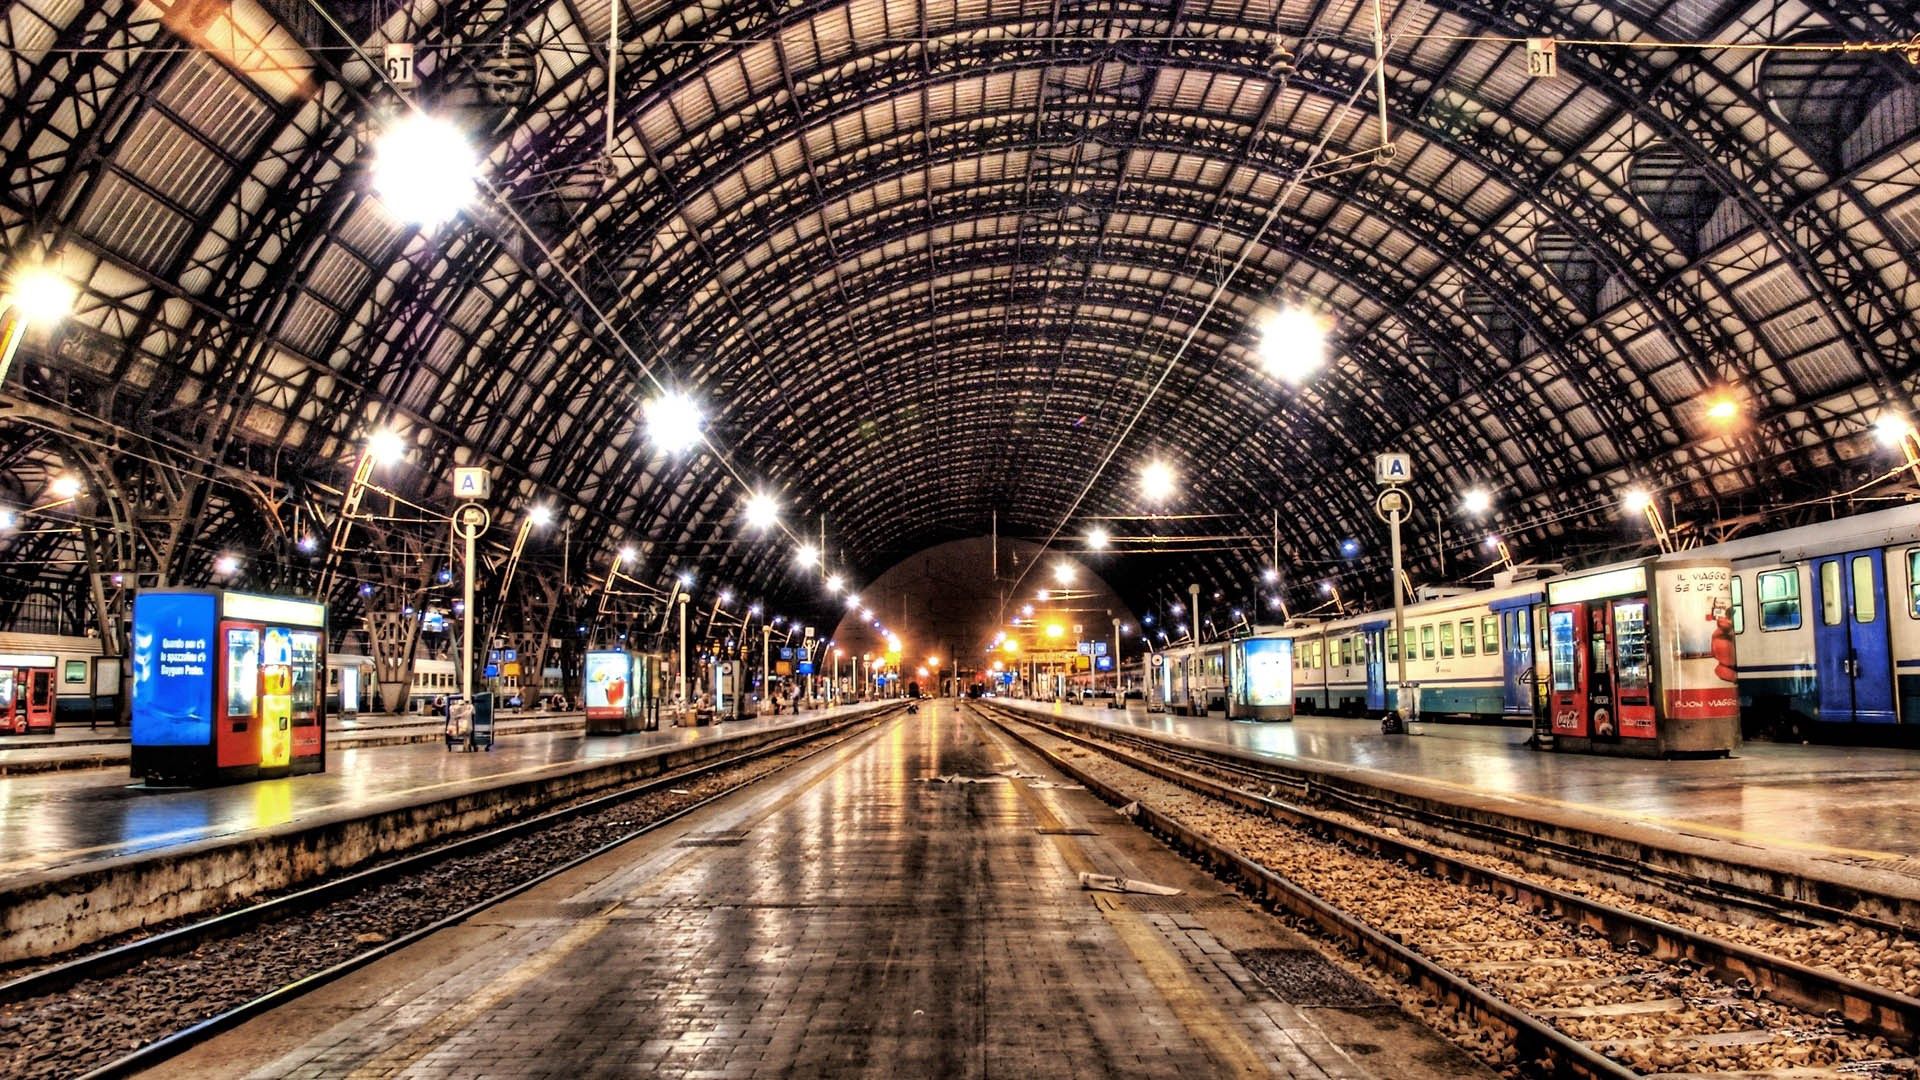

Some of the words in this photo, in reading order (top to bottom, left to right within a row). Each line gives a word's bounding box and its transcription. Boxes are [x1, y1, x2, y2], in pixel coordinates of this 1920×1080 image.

[387, 57, 410, 80] 6T
[1530, 51, 1553, 74] 6T
[1390, 459, 1404, 475] A
[461, 474, 474, 490] A
[1675, 584, 1690, 593] SE
